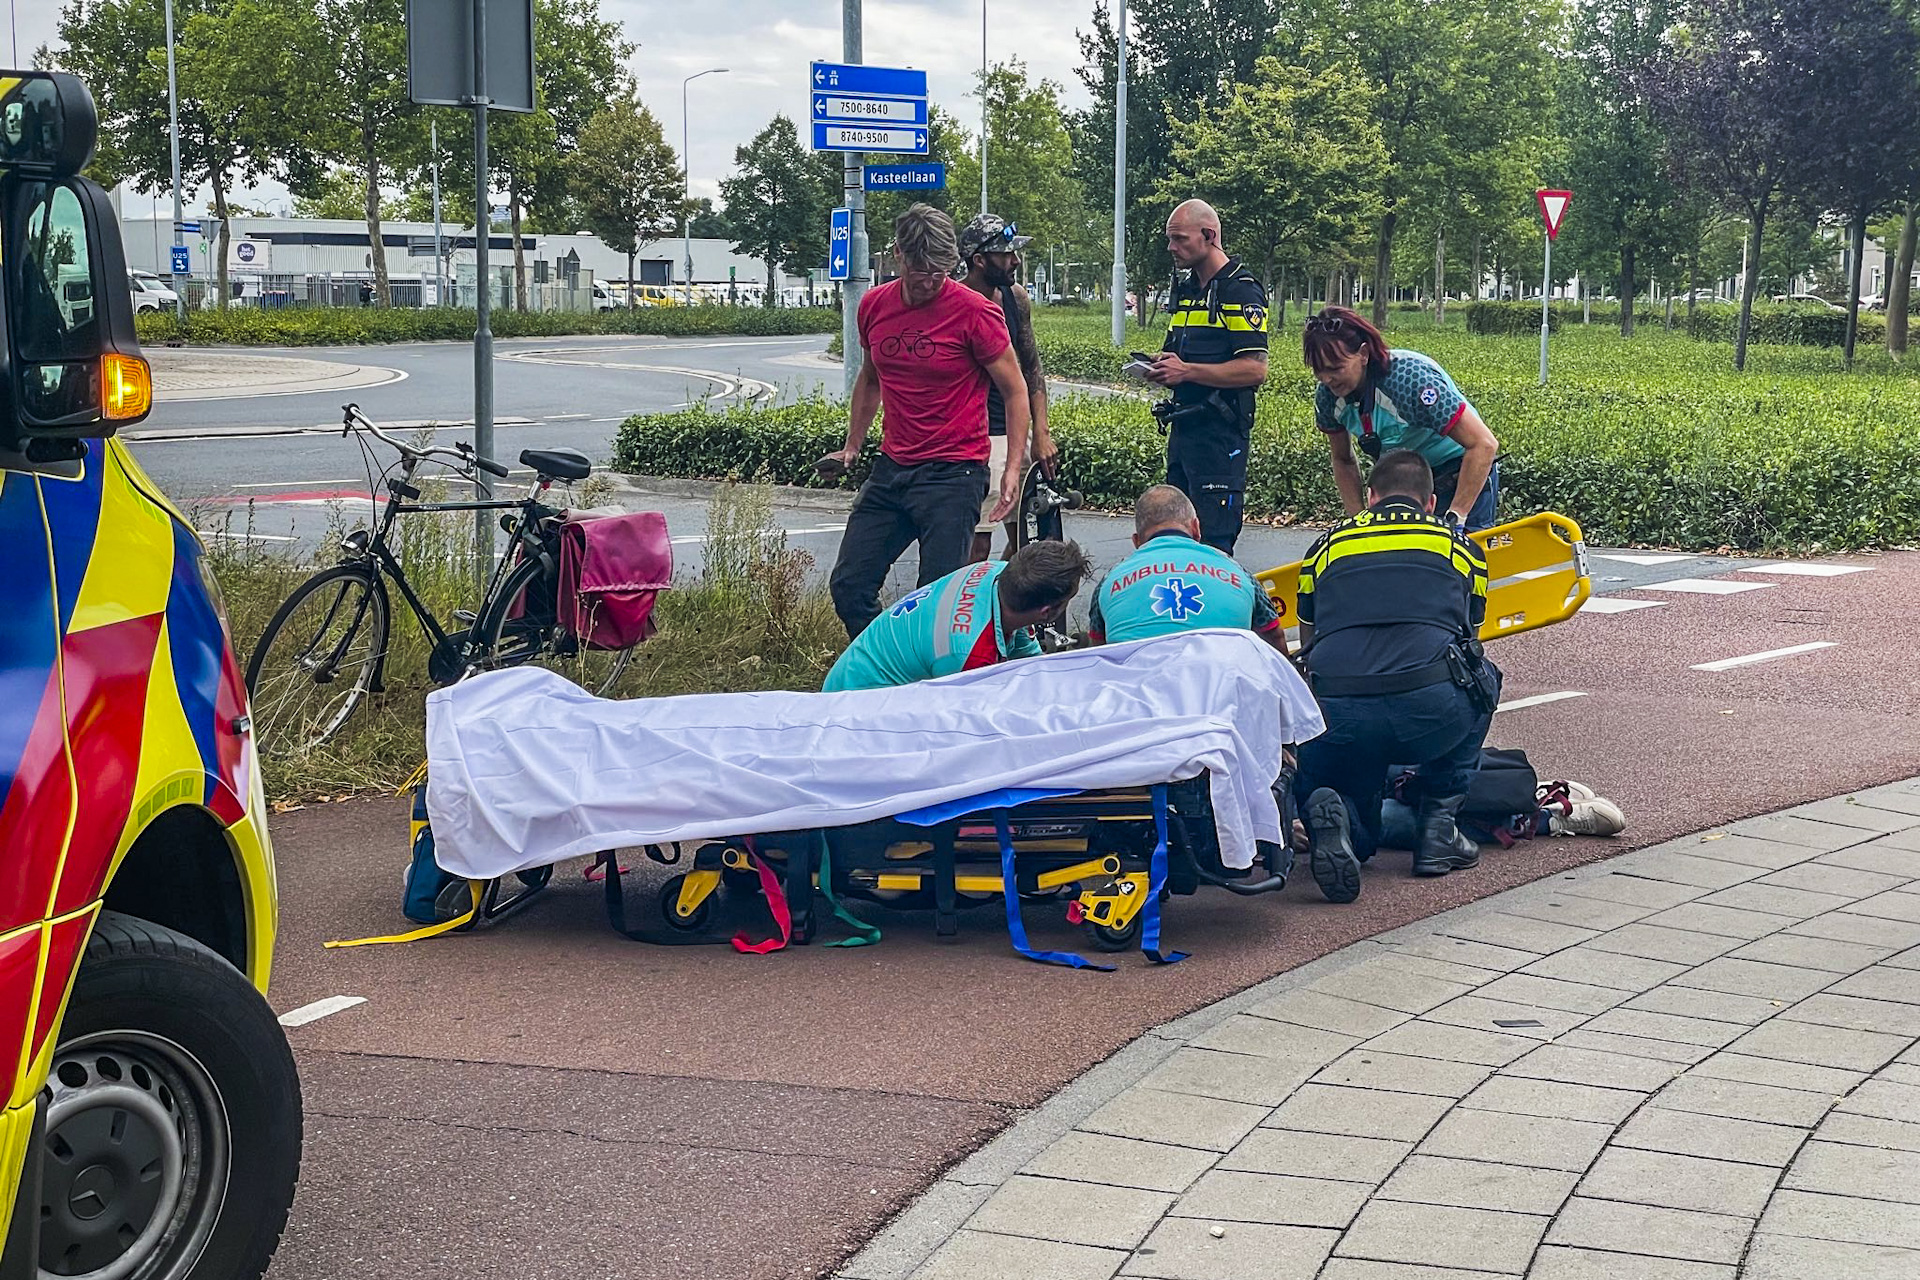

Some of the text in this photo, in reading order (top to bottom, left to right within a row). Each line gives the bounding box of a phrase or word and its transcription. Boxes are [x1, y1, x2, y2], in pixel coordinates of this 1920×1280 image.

[840, 101, 888, 115] 7500-8640
[840, 131, 889, 143] 8740-9500
[870, 170, 936, 184] Kasteellaan
[832, 226, 848, 241] U25
[1110, 563, 1242, 594] AMBULANCE
